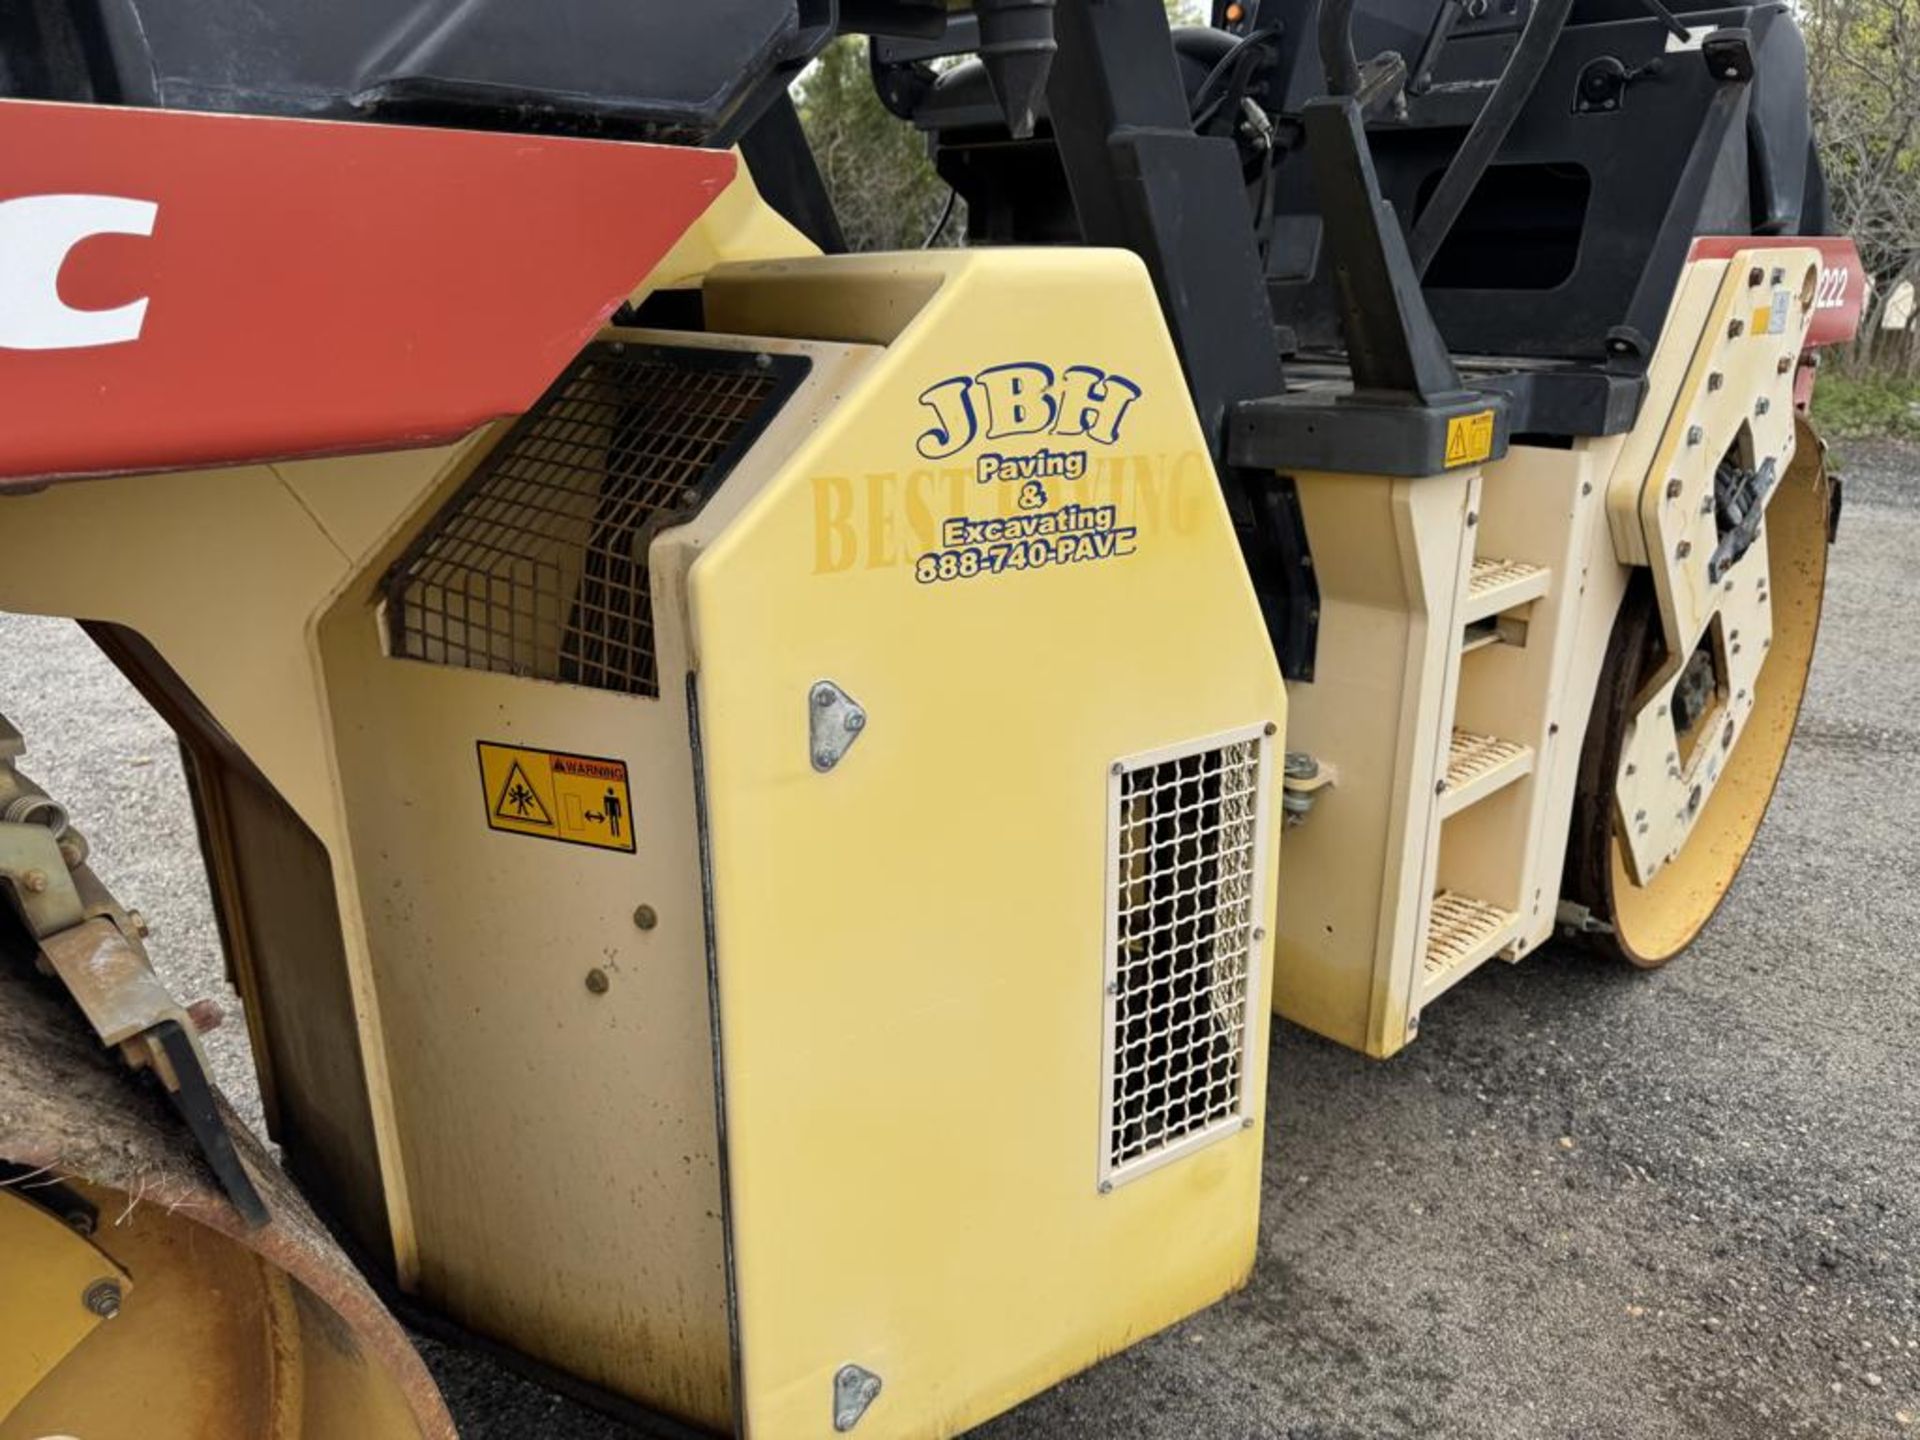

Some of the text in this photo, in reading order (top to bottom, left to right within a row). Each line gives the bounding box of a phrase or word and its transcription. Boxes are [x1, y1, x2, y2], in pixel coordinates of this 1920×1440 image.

[916, 361, 1142, 460] JBH
[977, 448, 1088, 484] Paving
[1018, 480, 1048, 510] &
[810, 467, 982, 576] BEST
[943, 504, 1117, 547] Excavating
[565, 760, 625, 782] WARNING
